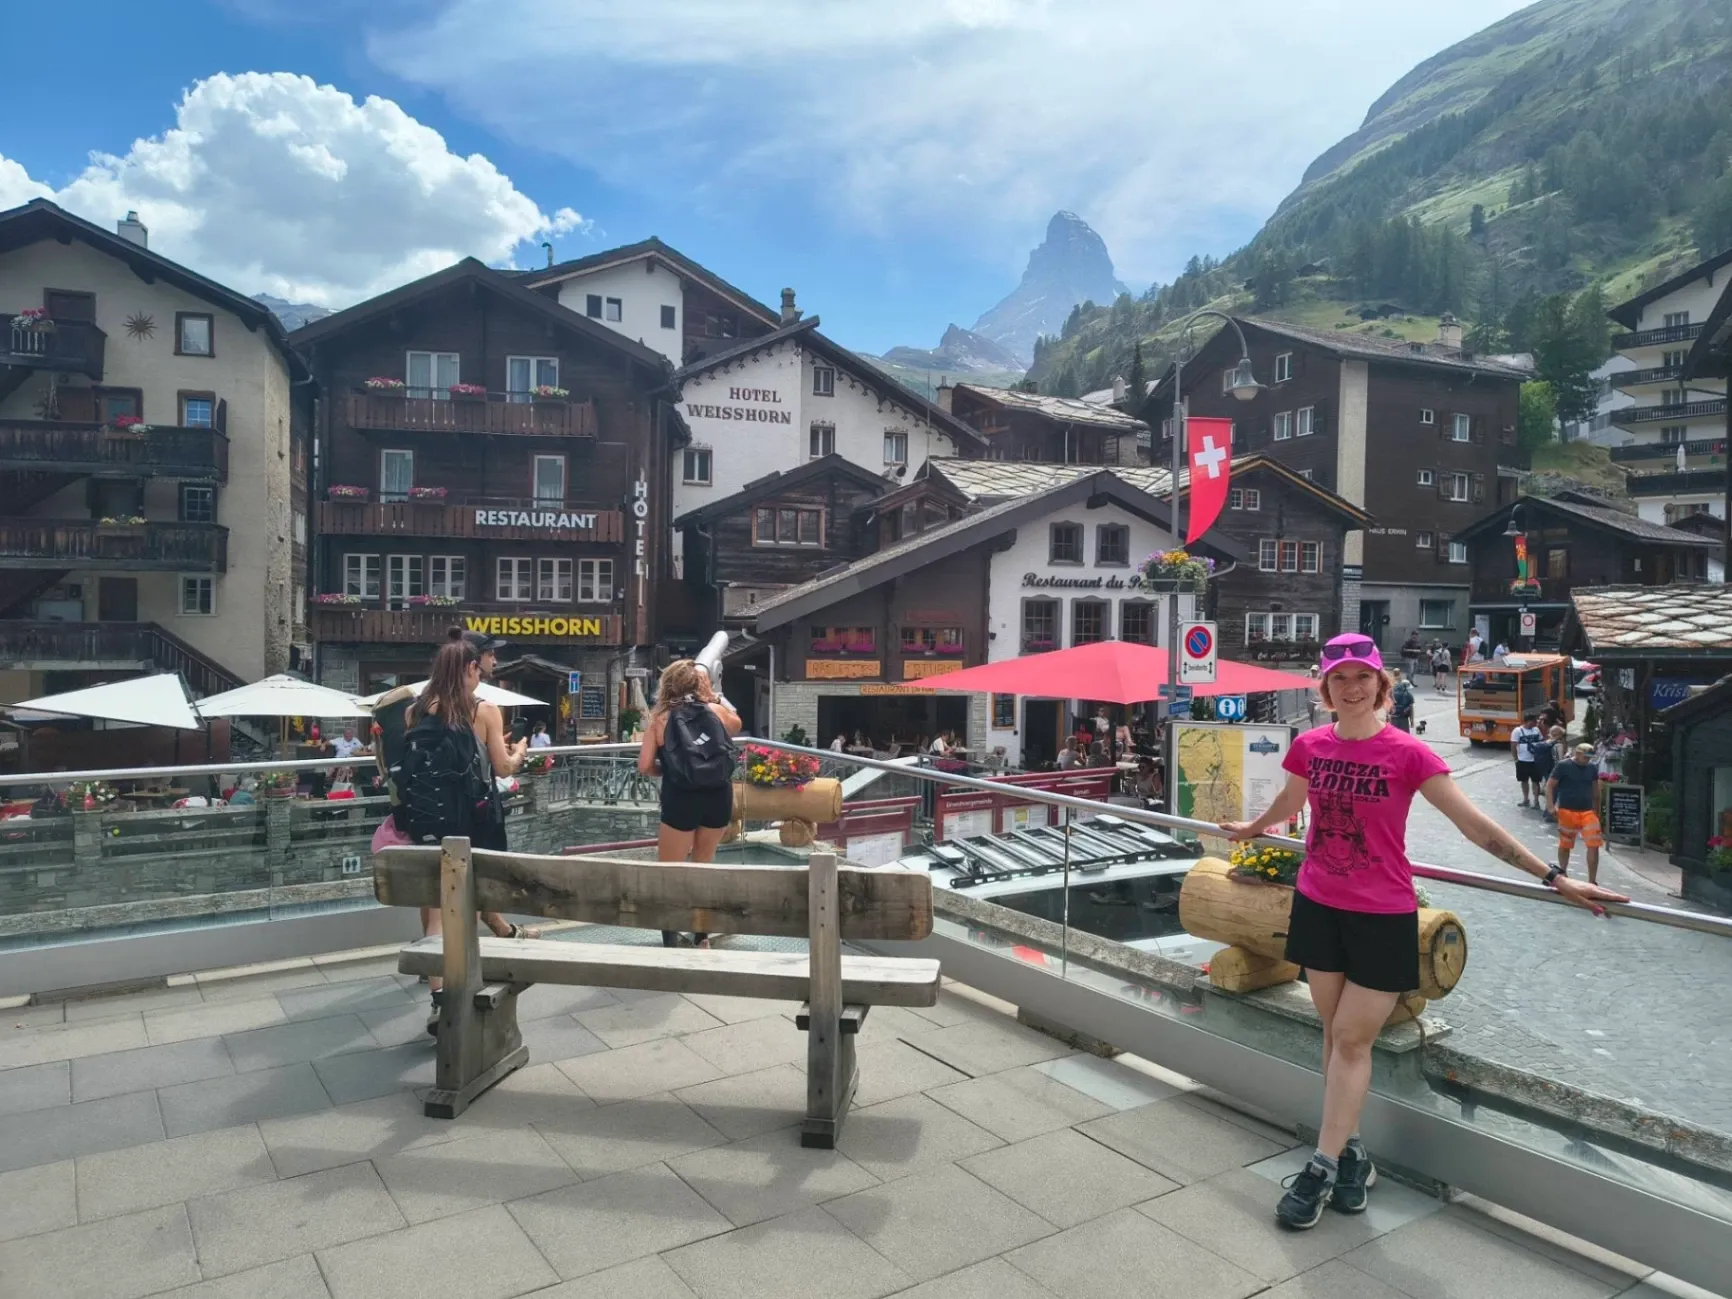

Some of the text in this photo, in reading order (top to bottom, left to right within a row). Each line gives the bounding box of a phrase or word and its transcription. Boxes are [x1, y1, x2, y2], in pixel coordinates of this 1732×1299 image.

[729, 387, 782, 403] HOTEL
[686, 403, 792, 424] WEISSHORN
[475, 510, 597, 529] RESTAURANT
[633, 481, 648, 575] HOTEL
[1021, 572, 1103, 588] Restaurant
[1105, 575, 1124, 589] du
[466, 616, 601, 636] WEISSHORN
[1312, 757, 1380, 778] UROCZA
